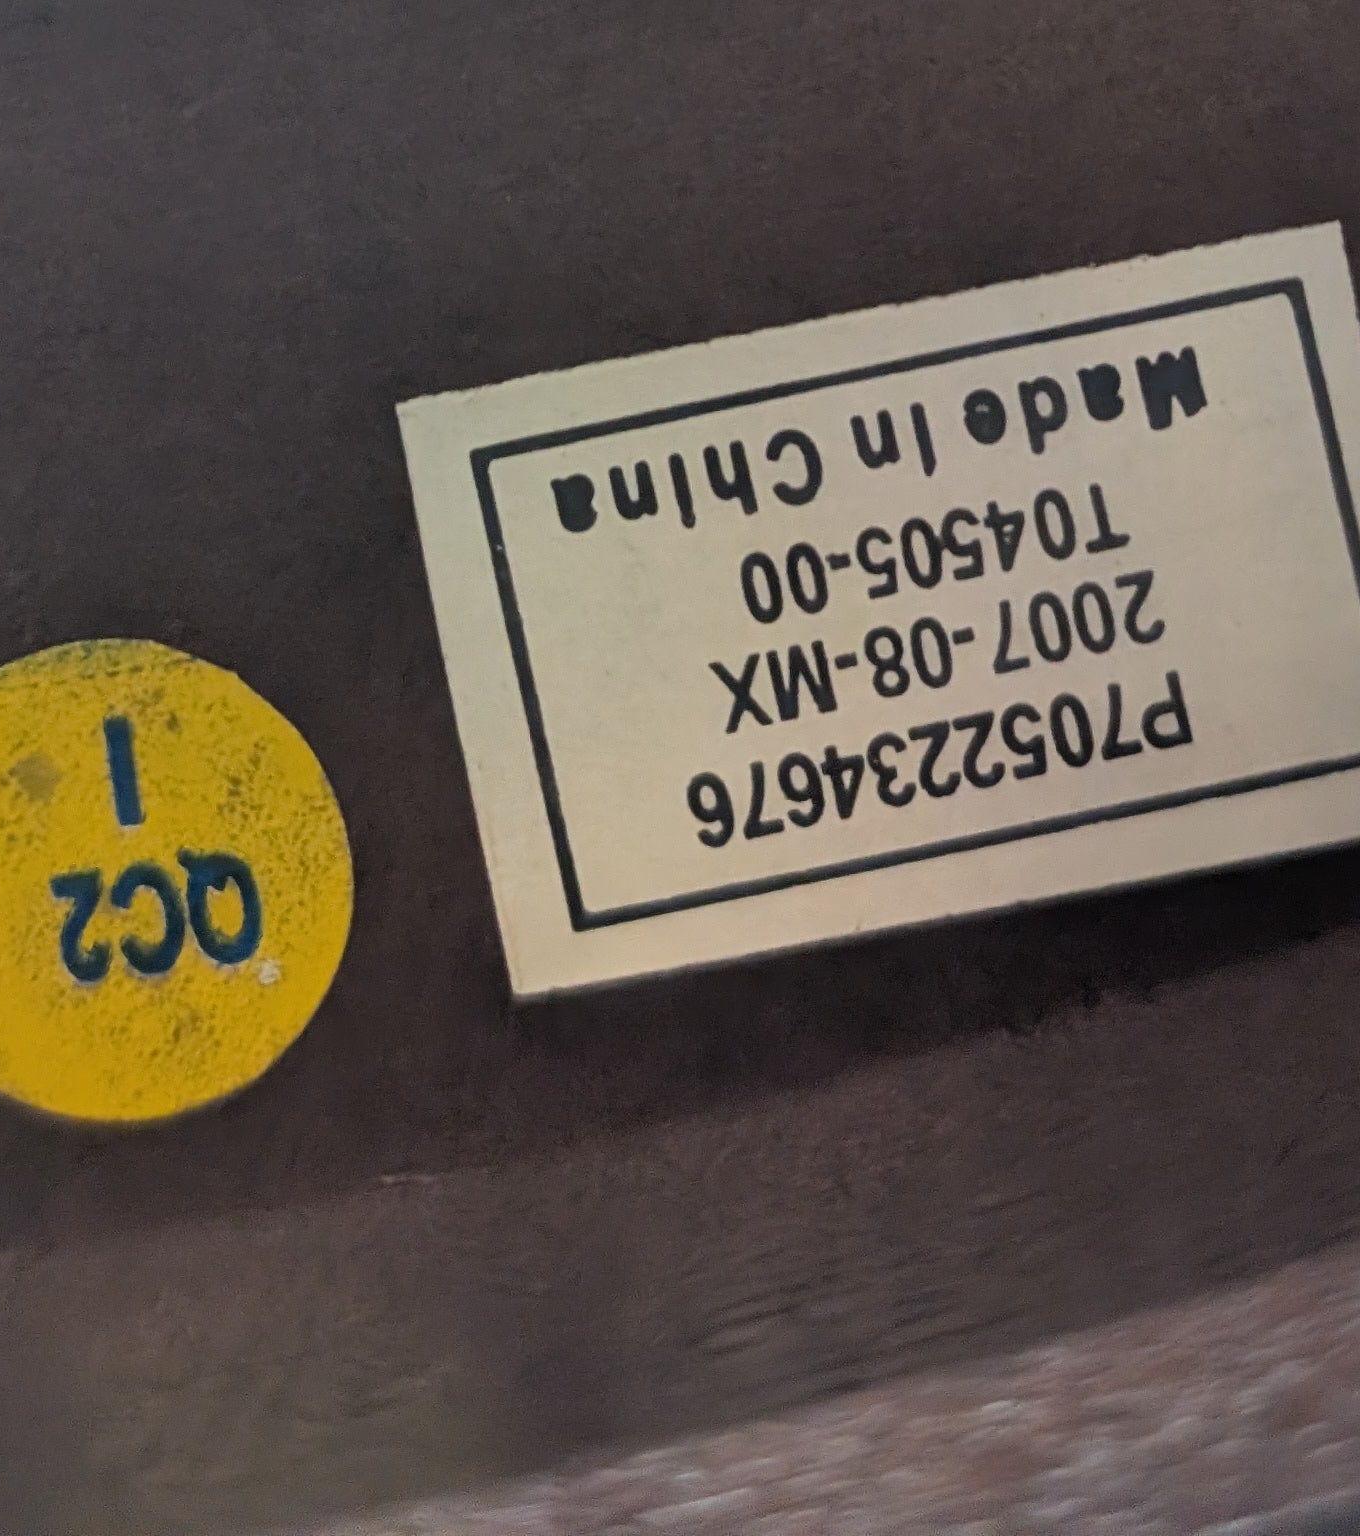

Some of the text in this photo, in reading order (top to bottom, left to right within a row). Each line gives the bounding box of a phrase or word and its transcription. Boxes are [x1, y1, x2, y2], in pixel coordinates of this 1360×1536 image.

[962, 345, 1209, 457] Made
[549, 428, 824, 535] China
[739, 483, 1132, 626] T04505-00
[706, 569, 1167, 736] 2007-08-MX
[685, 670, 1195, 850] P7052234676
[48, 848, 263, 984] QC2
